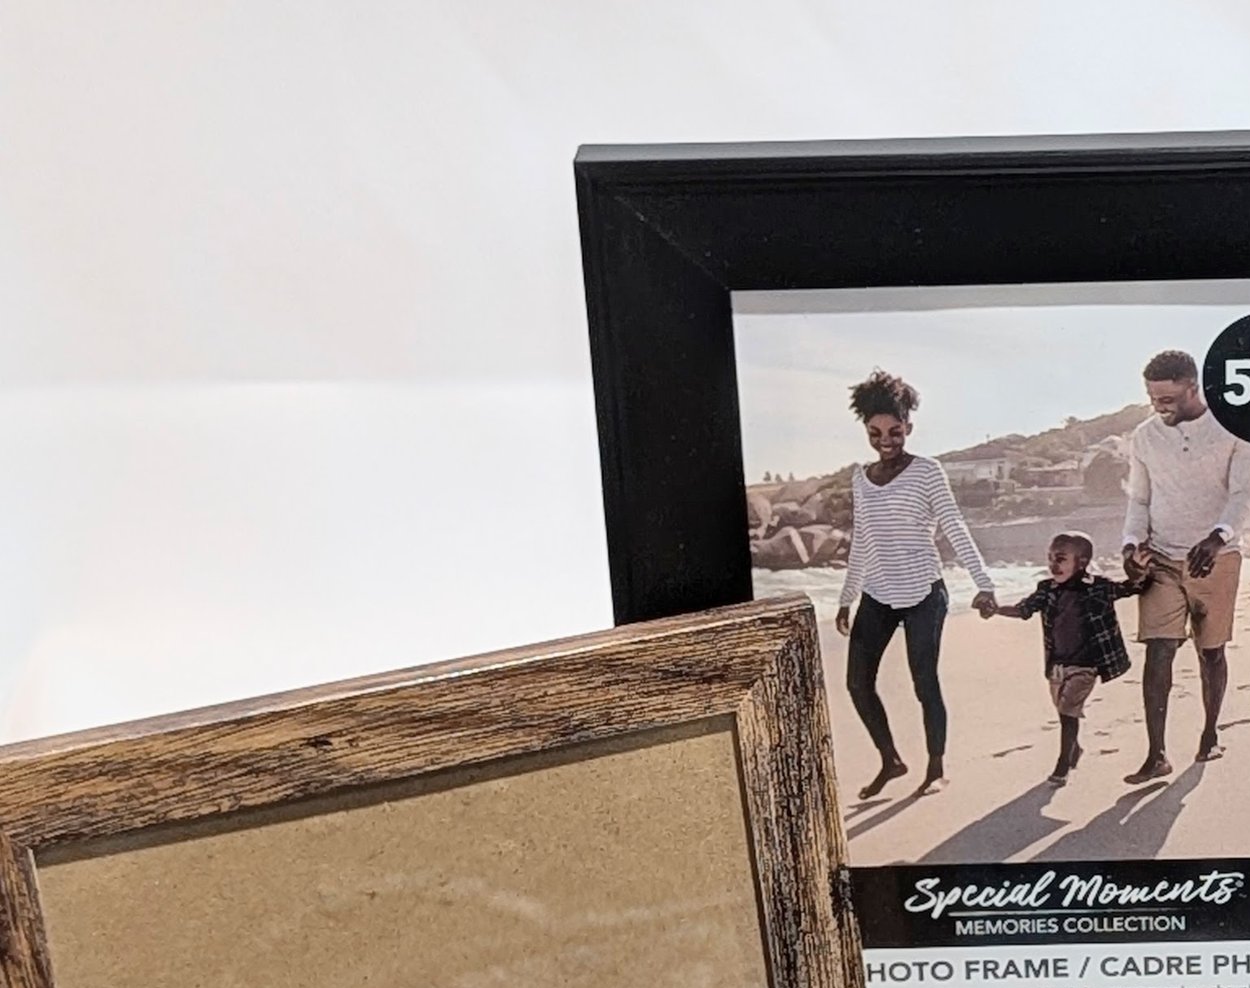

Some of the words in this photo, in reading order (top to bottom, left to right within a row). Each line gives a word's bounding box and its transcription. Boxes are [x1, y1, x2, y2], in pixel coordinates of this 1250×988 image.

[904, 870, 1056, 920] Special
[1059, 870, 1245, 907] Moments
[955, 917, 1058, 936] MEMORIES
[1063, 915, 1186, 934] COLLECTION
[867, 960, 953, 982] HOTO
[965, 957, 1069, 980] FRAME
[1078, 956, 1091, 978] /
[1100, 955, 1202, 977] CADRE
